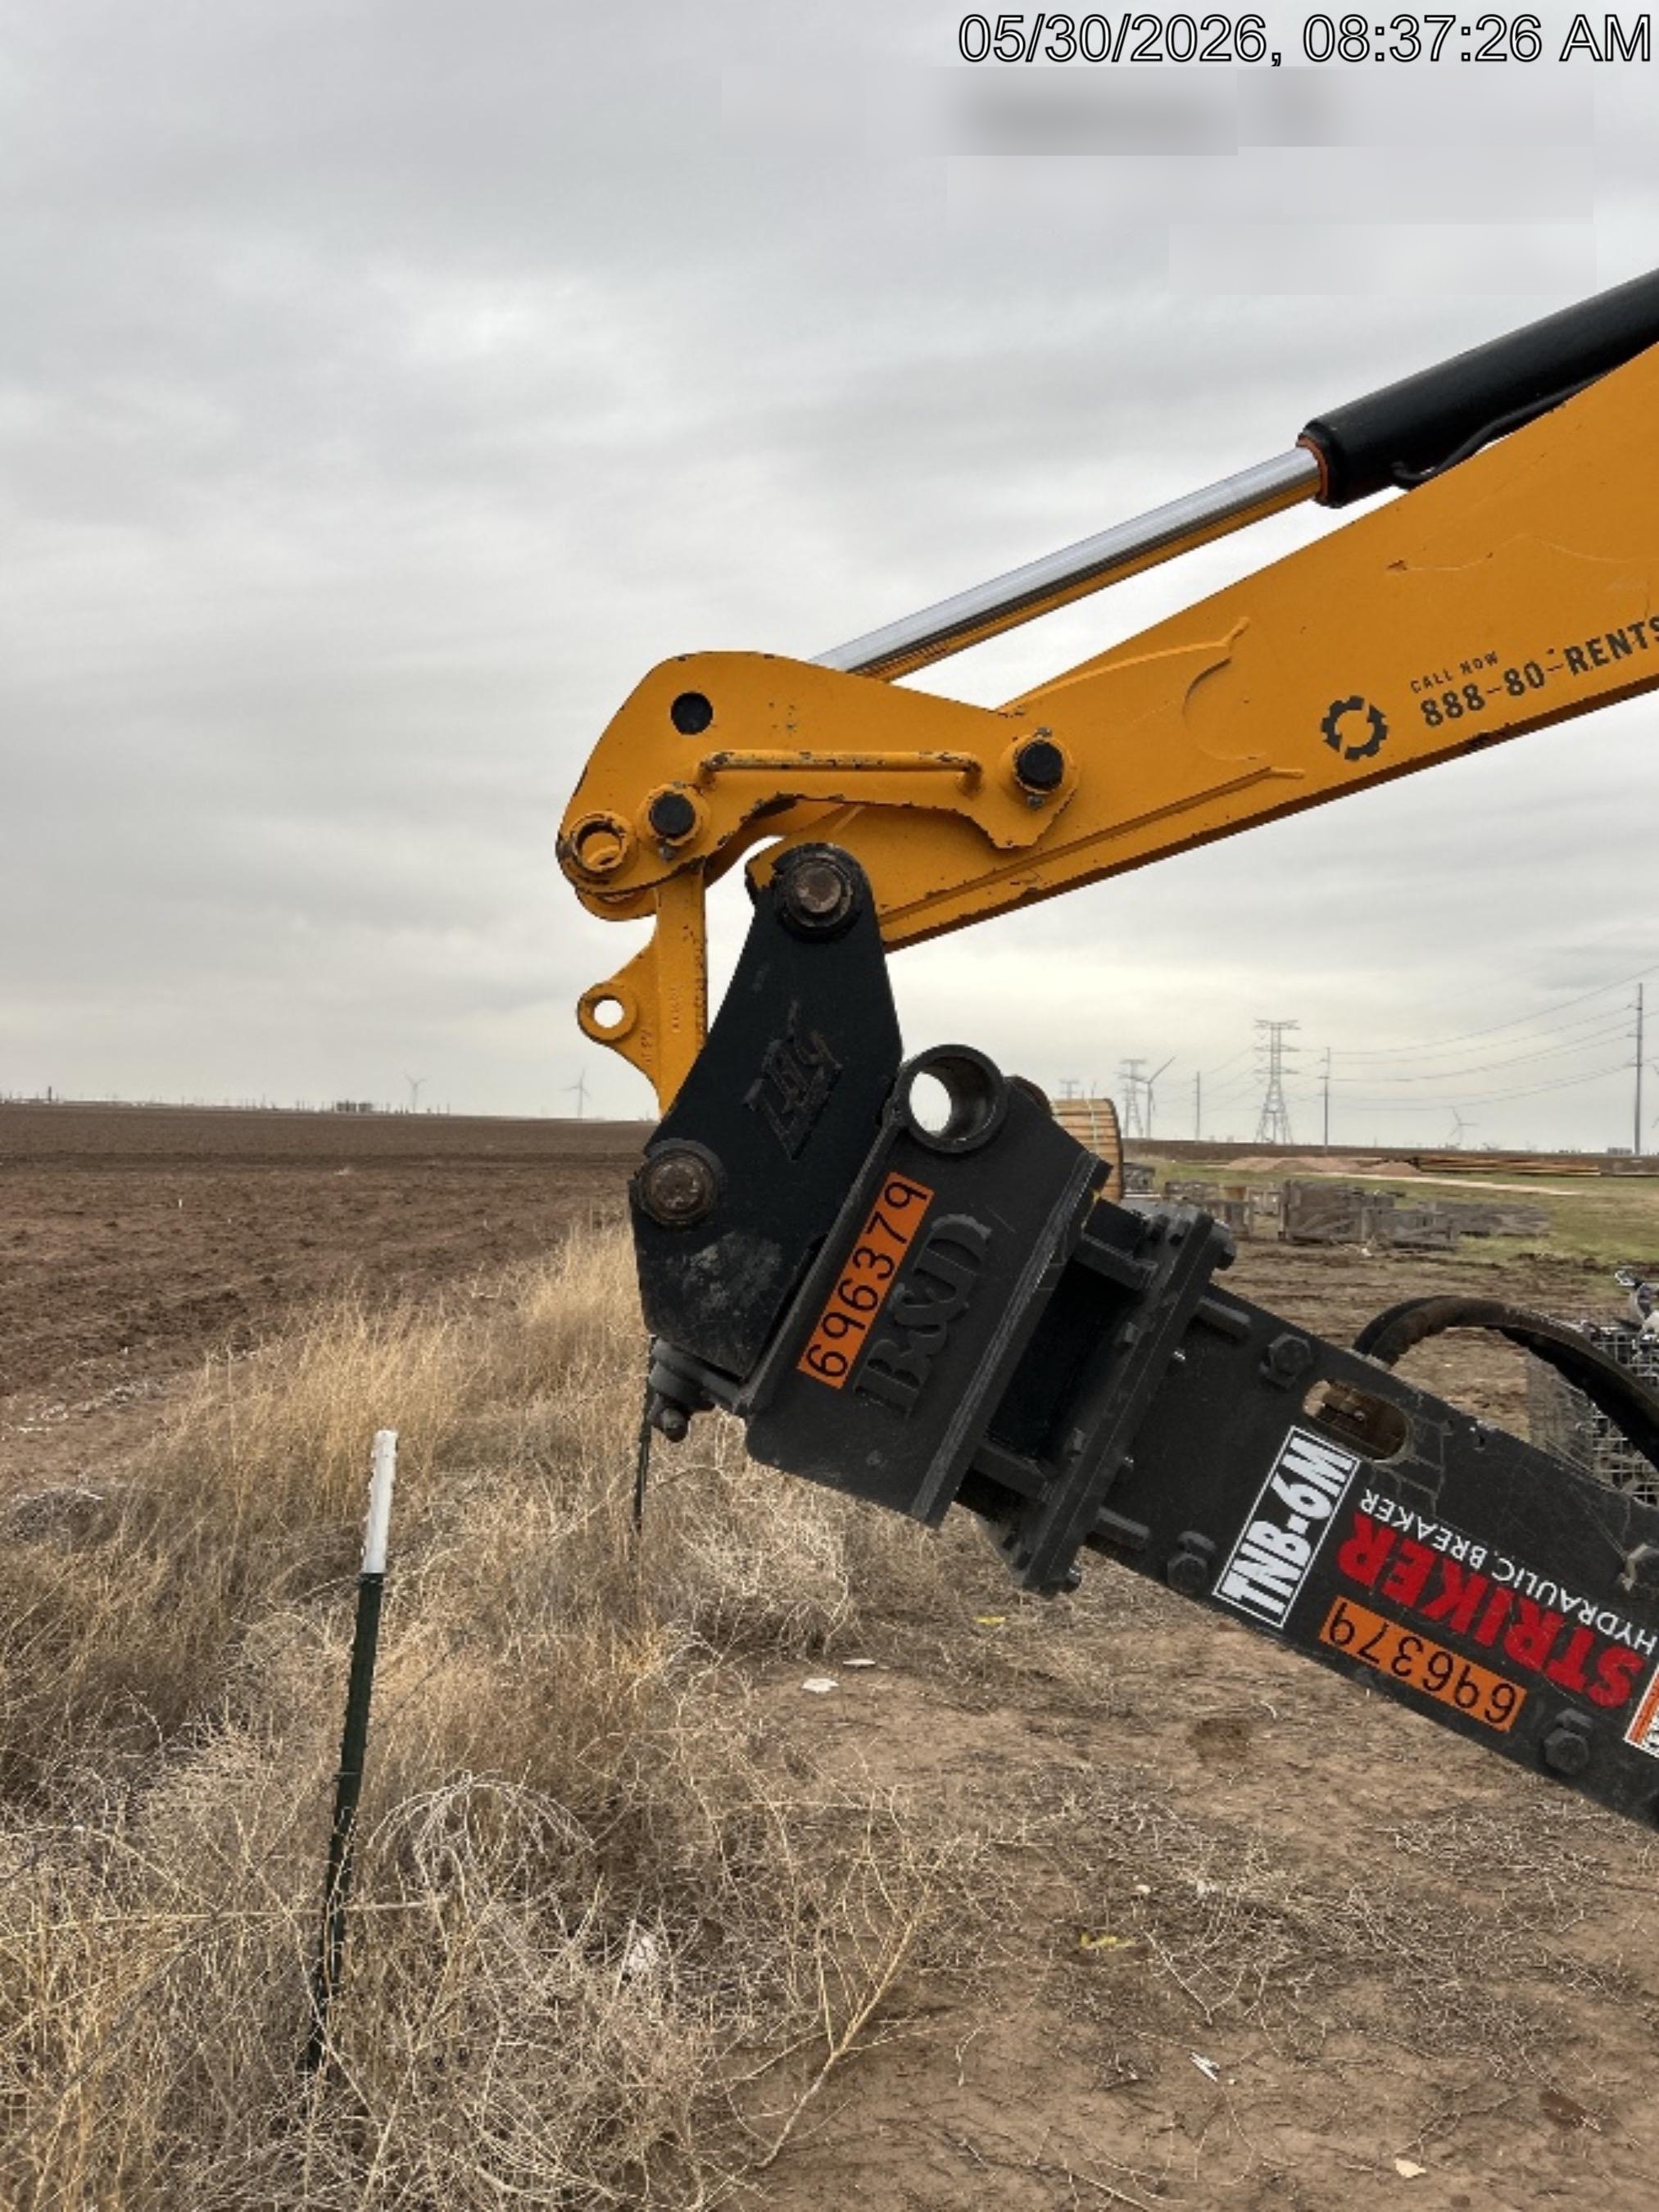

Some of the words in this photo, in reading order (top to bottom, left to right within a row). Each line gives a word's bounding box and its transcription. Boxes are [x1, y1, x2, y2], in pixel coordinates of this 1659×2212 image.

[1410, 669, 1453, 694] CALL
[1460, 650, 1500, 675] NOW
[806, 1181, 927, 1378] 696379
[1220, 1436, 1353, 1615] TNB-6M
[1359, 1489, 1489, 1570] BREAKER
[1328, 1602, 1517, 1724] 696379
[1337, 1512, 1645, 1708] STRIKER
[1491, 1561, 1657, 1657] HYDRAULIC
